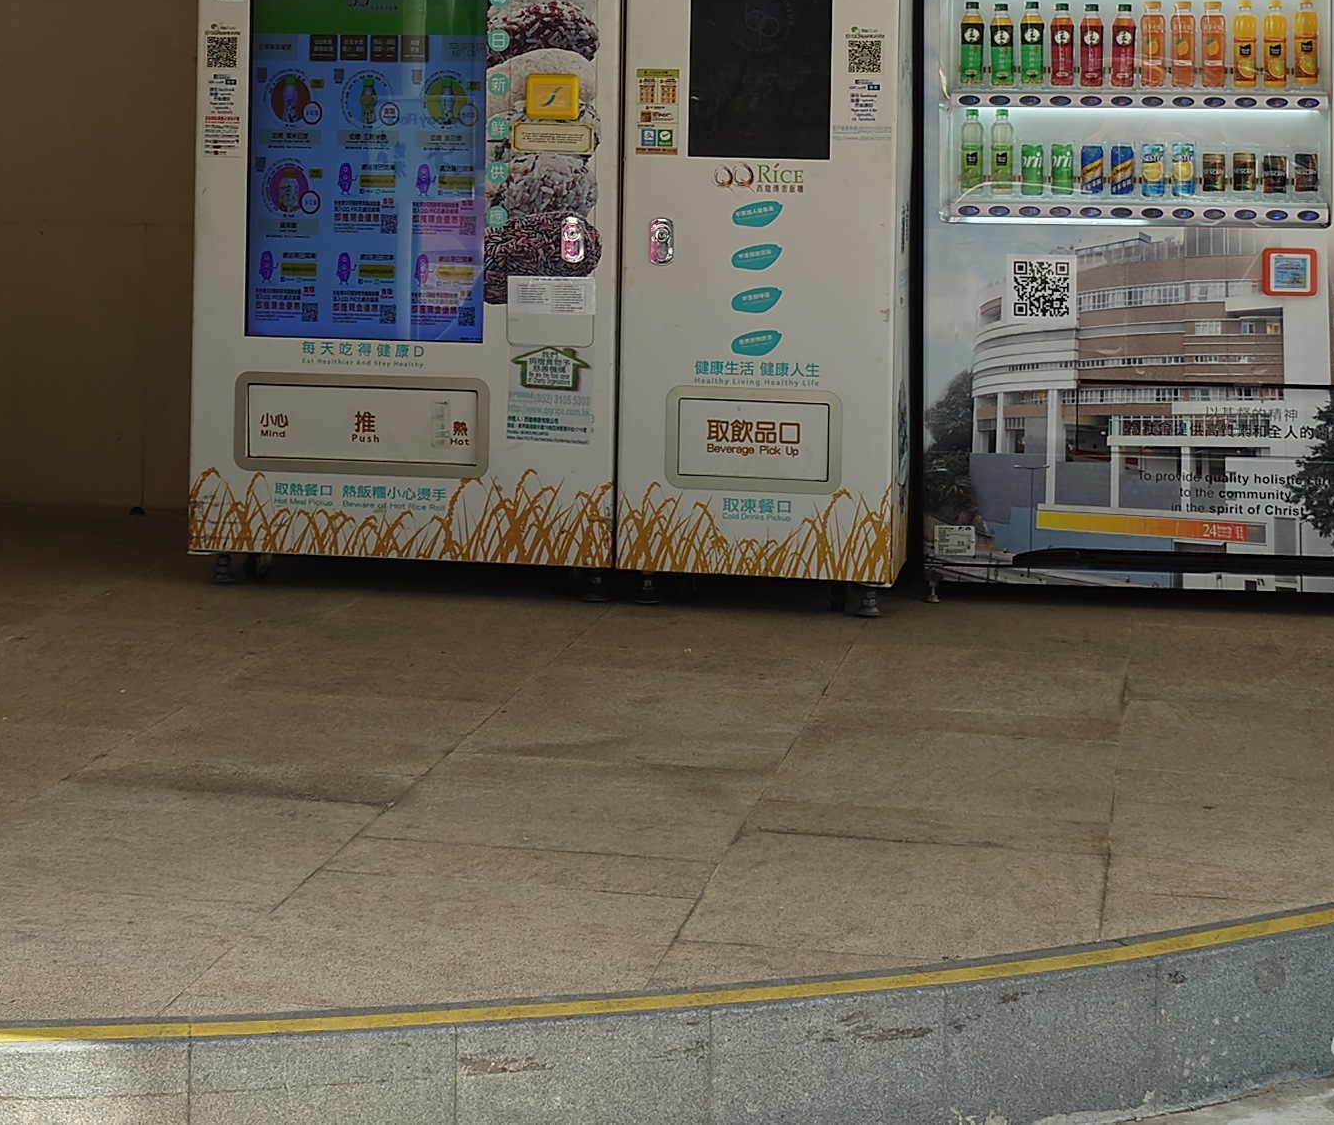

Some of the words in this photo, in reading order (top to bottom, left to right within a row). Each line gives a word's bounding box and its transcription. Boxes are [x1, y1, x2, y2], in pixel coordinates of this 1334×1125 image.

[302, 341, 424, 358] 每天吃得健康D
[542, 351, 558, 359] 我們
[394, 361, 424, 369] Healthy
[695, 360, 754, 376] 健康生活
[759, 361, 820, 378] 健康人生
[694, 377, 729, 387] Healthy
[732, 378, 760, 387] Living
[764, 379, 799, 388] Healthy
[802, 379, 820, 387] Life
[260, 413, 288, 428] 小心
[1205, 405, 1298, 423] 以基督的精神
[354, 411, 376, 433] 推
[452, 421, 468, 436] 熱
[260, 430, 286, 438] Mind
[351, 434, 380, 443] Push
[707, 419, 801, 444] 取飲品口
[450, 438, 469, 446] Hot
[707, 444, 754, 457] Beverage
[759, 445, 781, 456] Pick
[785, 446, 799, 458] Up
[1139, 470, 1151, 482] To
[1155, 472, 1201, 484] provide
[1205, 473, 1250, 486] quality
[1254, 473, 1302, 485] holistic
[274, 482, 333, 496] 取熱餐口
[342, 485, 446, 501] 熱飯糰小心燙手
[1179, 488, 1191, 498] to
[1195, 488, 1214, 498] the
[1219, 489, 1291, 503] community
[290, 498, 307, 506] Meal
[309, 499, 333, 507] Pickup
[342, 500, 375, 508] Beware
[377, 501, 387, 509] of
[390, 502, 406, 510] Hot
[722, 497, 792, 514] 取凍餐口
[1171, 503, 1181, 512] in
[1186, 503, 1204, 513] the
[1209, 504, 1242, 516] spirit
[1247, 504, 1260, 515] of
[1265, 504, 1305, 516] Christ
[740, 513, 764, 521] Drinks
[766, 514, 792, 523] Pickup
[1202, 524, 1217, 537] 24
